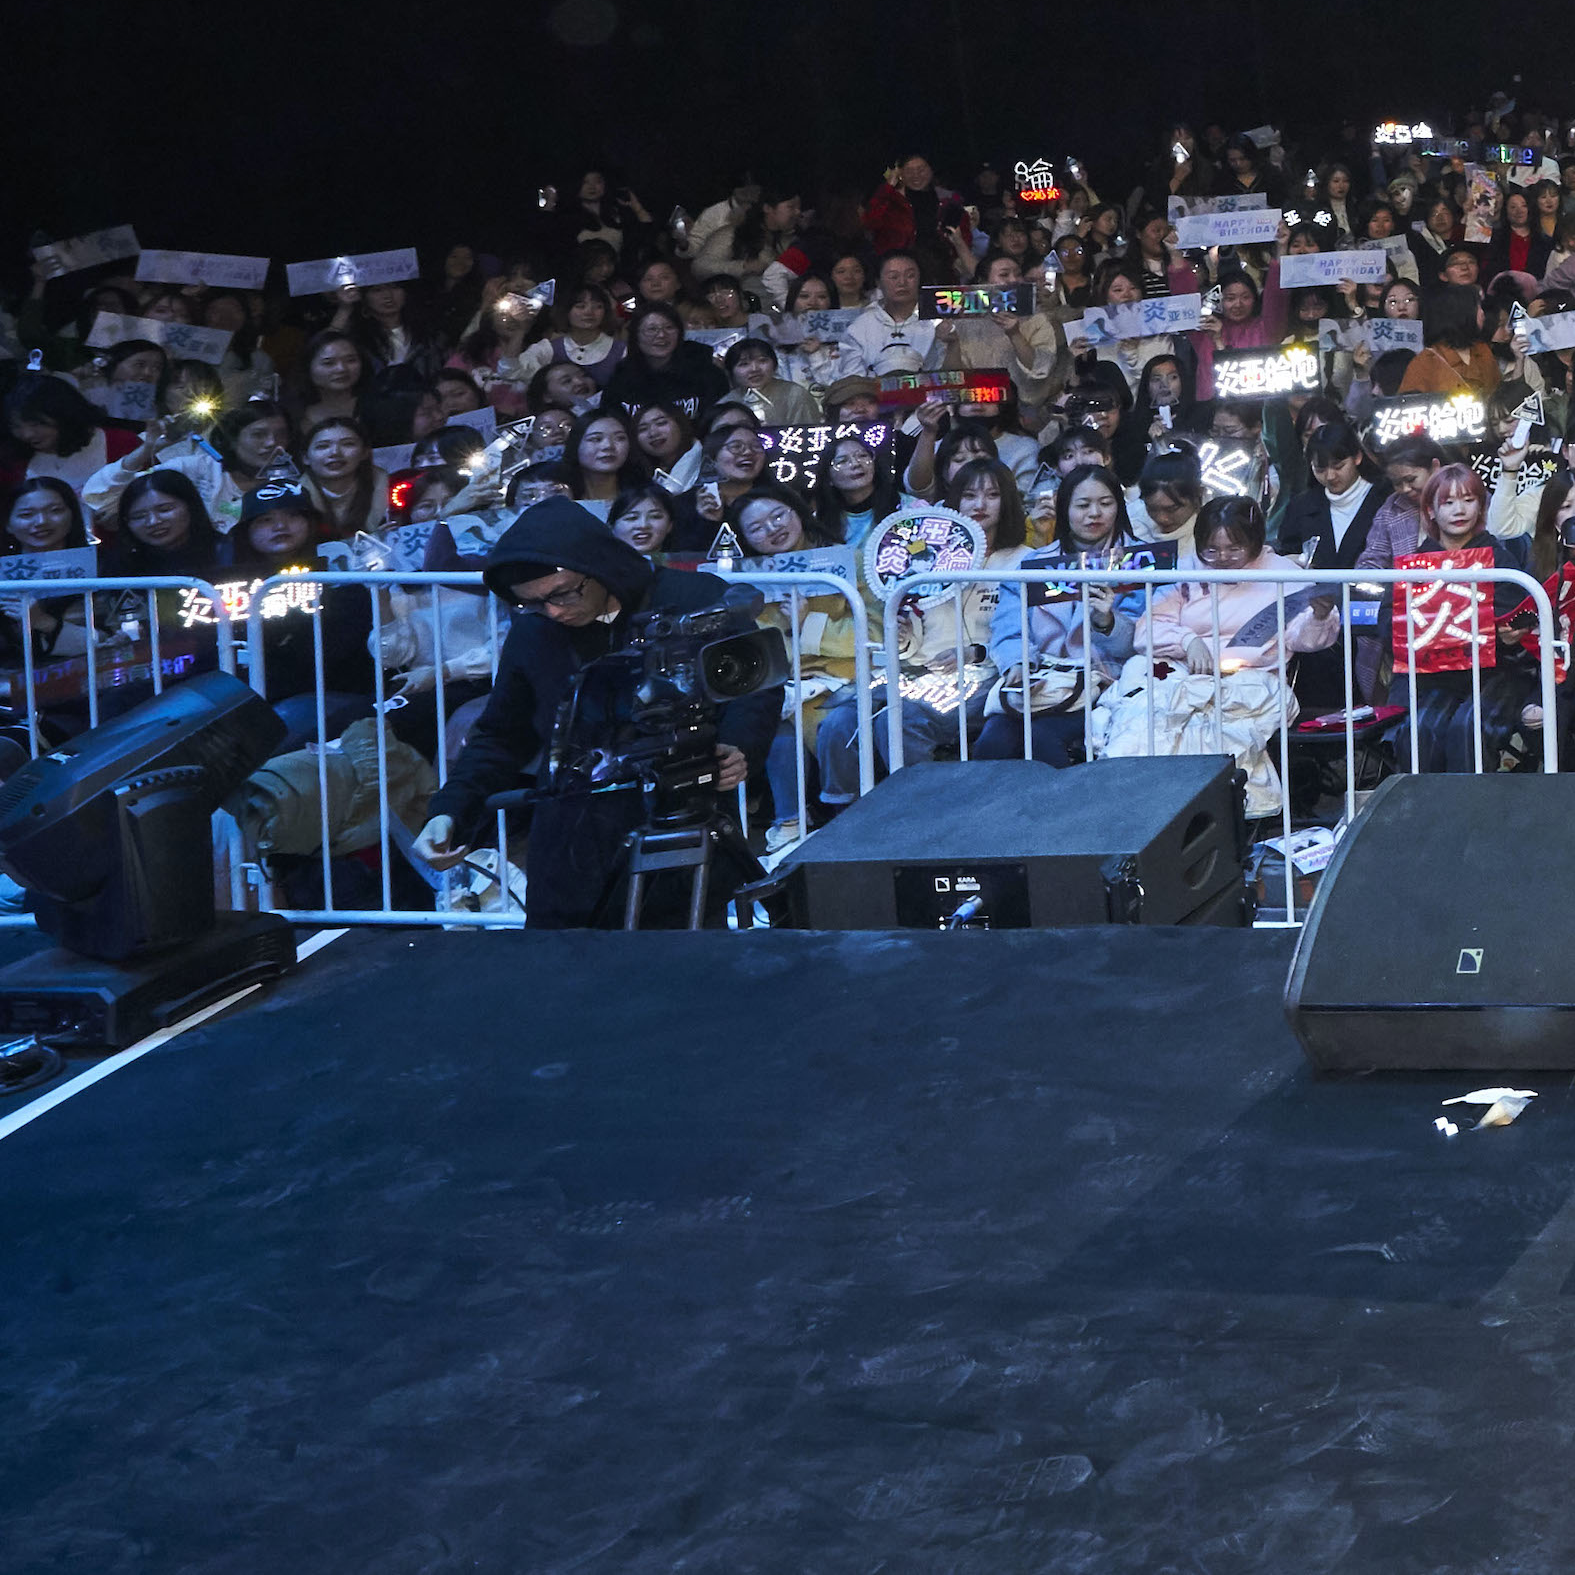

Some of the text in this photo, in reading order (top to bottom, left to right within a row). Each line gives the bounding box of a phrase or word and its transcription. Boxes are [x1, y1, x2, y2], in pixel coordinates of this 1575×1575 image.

[1325, 266, 1382, 276] BIRTHDAY
[1144, 302, 1195, 322] 炎亚纶
[1373, 322, 1417, 342] 炎亚纶
[980, 594, 1000, 604] FIL
